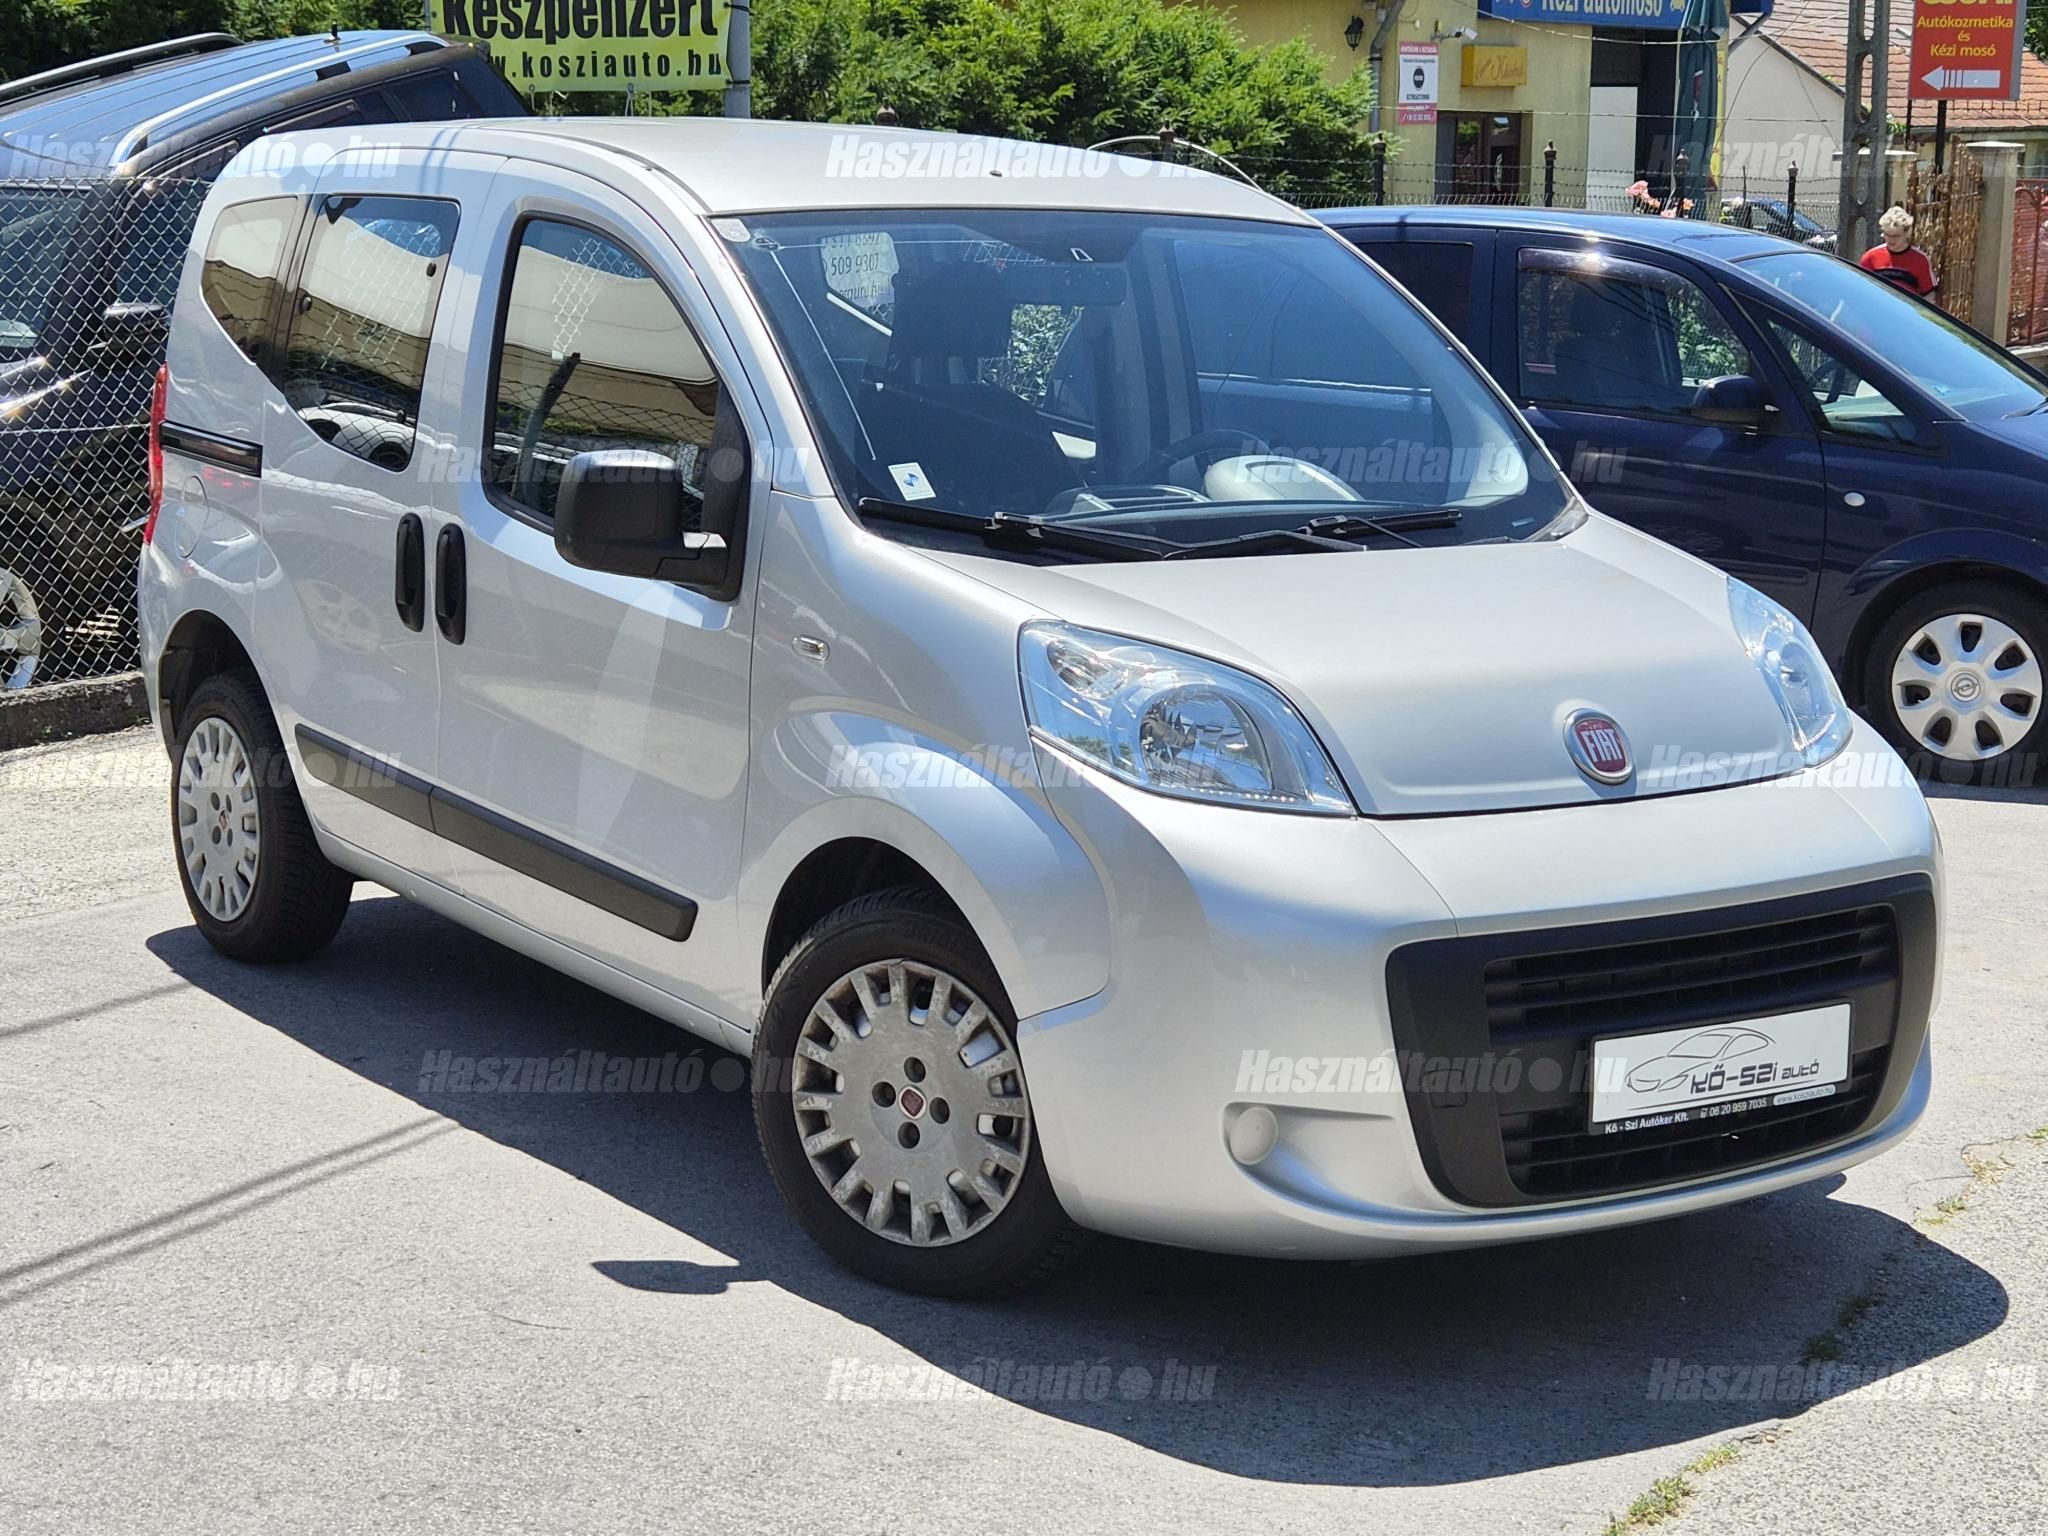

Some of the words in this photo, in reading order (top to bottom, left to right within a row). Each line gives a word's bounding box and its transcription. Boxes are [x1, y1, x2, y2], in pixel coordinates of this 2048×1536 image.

[1916, 16, 2014, 28] Autókozmetika
[1957, 30, 1971, 42] és
[1930, 44, 1957, 57] Kézi
[1960, 43, 1997, 57] mosó
[831, 255, 852, 276] 509
[855, 253, 880, 273] 9307
[1580, 728, 1623, 762] FIAT
[1639, 1114, 1673, 1128] Autóker
